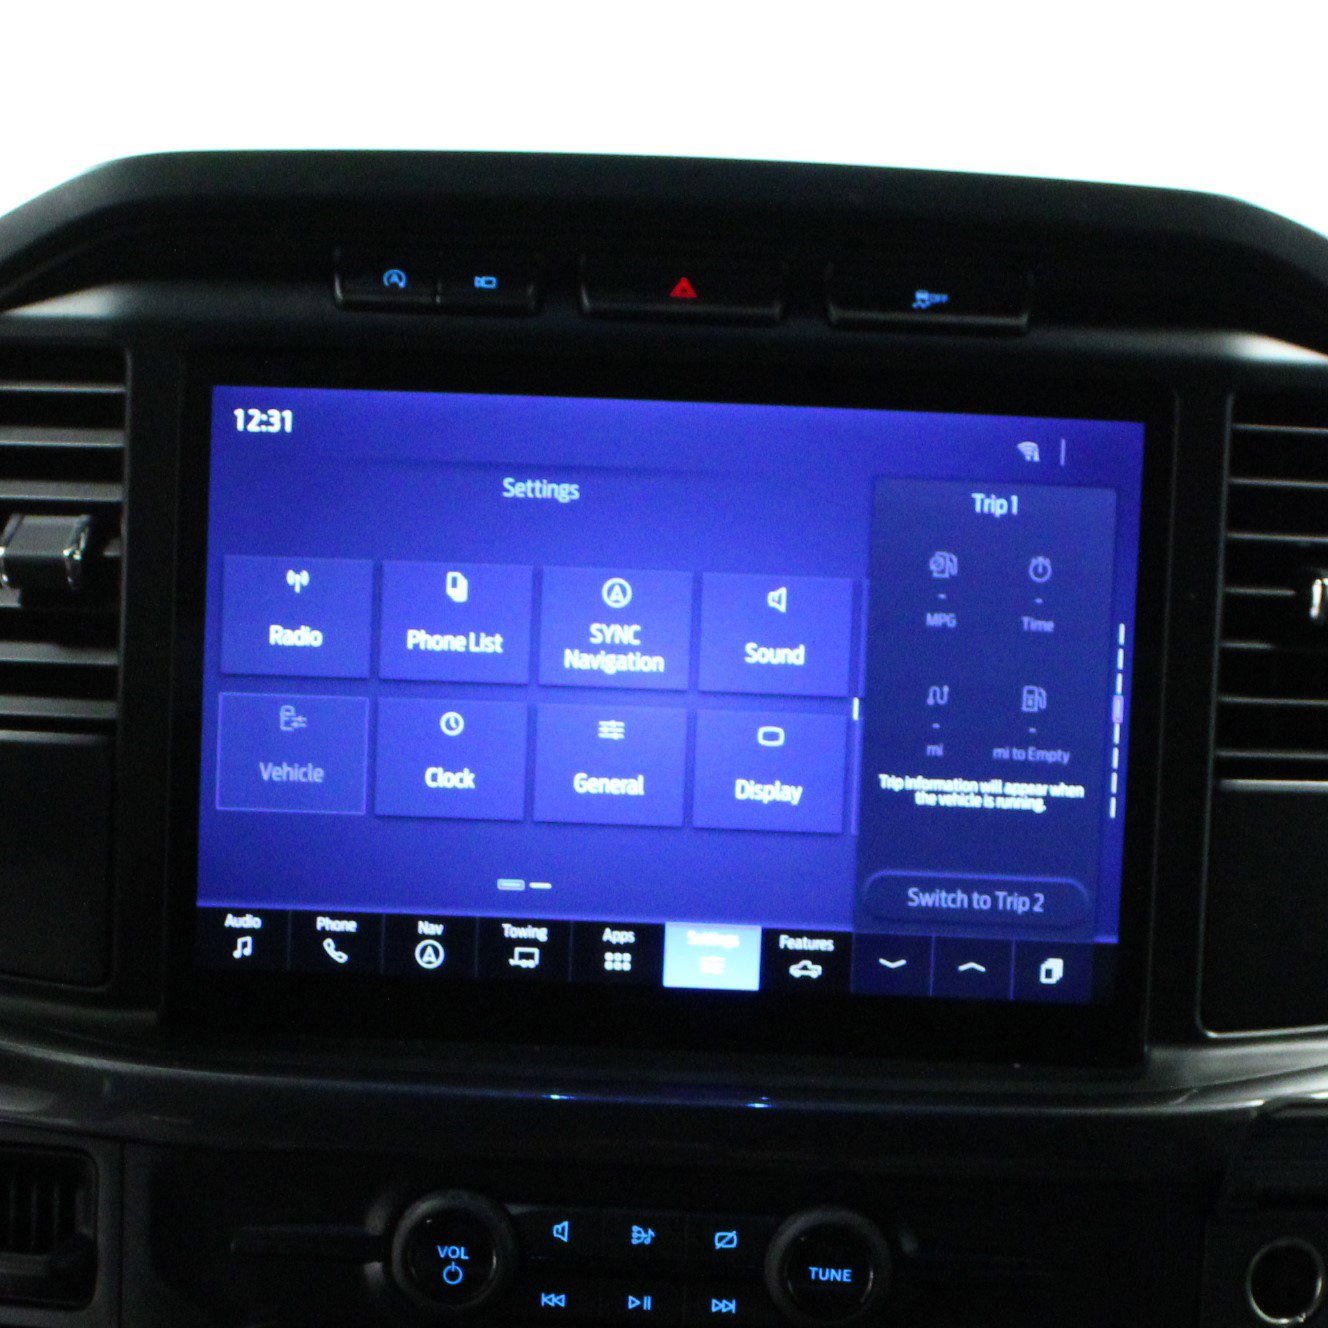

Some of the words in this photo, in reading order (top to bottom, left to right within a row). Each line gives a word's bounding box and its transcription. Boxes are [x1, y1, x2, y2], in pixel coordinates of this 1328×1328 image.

[233, 408, 293, 433] 12:31
[502, 477, 580, 502] Settings
[972, 493, 1008, 518] Trip
[1011, 495, 1018, 515] 1
[926, 612, 957, 629] MPG
[1022, 616, 1055, 633] Time
[269, 625, 323, 648] Radio
[407, 629, 467, 653] Phone
[469, 632, 504, 654] List
[590, 624, 642, 645] SYNC
[563, 648, 665, 675] Navigation
[744, 643, 805, 666] Sound
[927, 743, 944, 757] mi
[993, 746, 1010, 759] mi
[1012, 747, 1026, 761] to
[1028, 747, 1070, 764] Empty
[260, 760, 324, 784] Vehicle
[424, 766, 475, 789] Clock
[573, 773, 644, 796] General
[735, 779, 803, 805] Display
[879, 774, 904, 791] Trip
[907, 887, 968, 910] Switch
[972, 891, 991, 910] to
[995, 892, 1030, 914] Trip
[1033, 894, 1044, 912] 2
[224, 914, 261, 930] Audio
[317, 916, 357, 933] Phone
[418, 921, 443, 936] Nav
[502, 924, 548, 942] Towing
[603, 929, 635, 945] Apps
[779, 934, 834, 951] Features
[437, 1245, 469, 1259] VOL
[809, 1267, 852, 1282] TUNE
